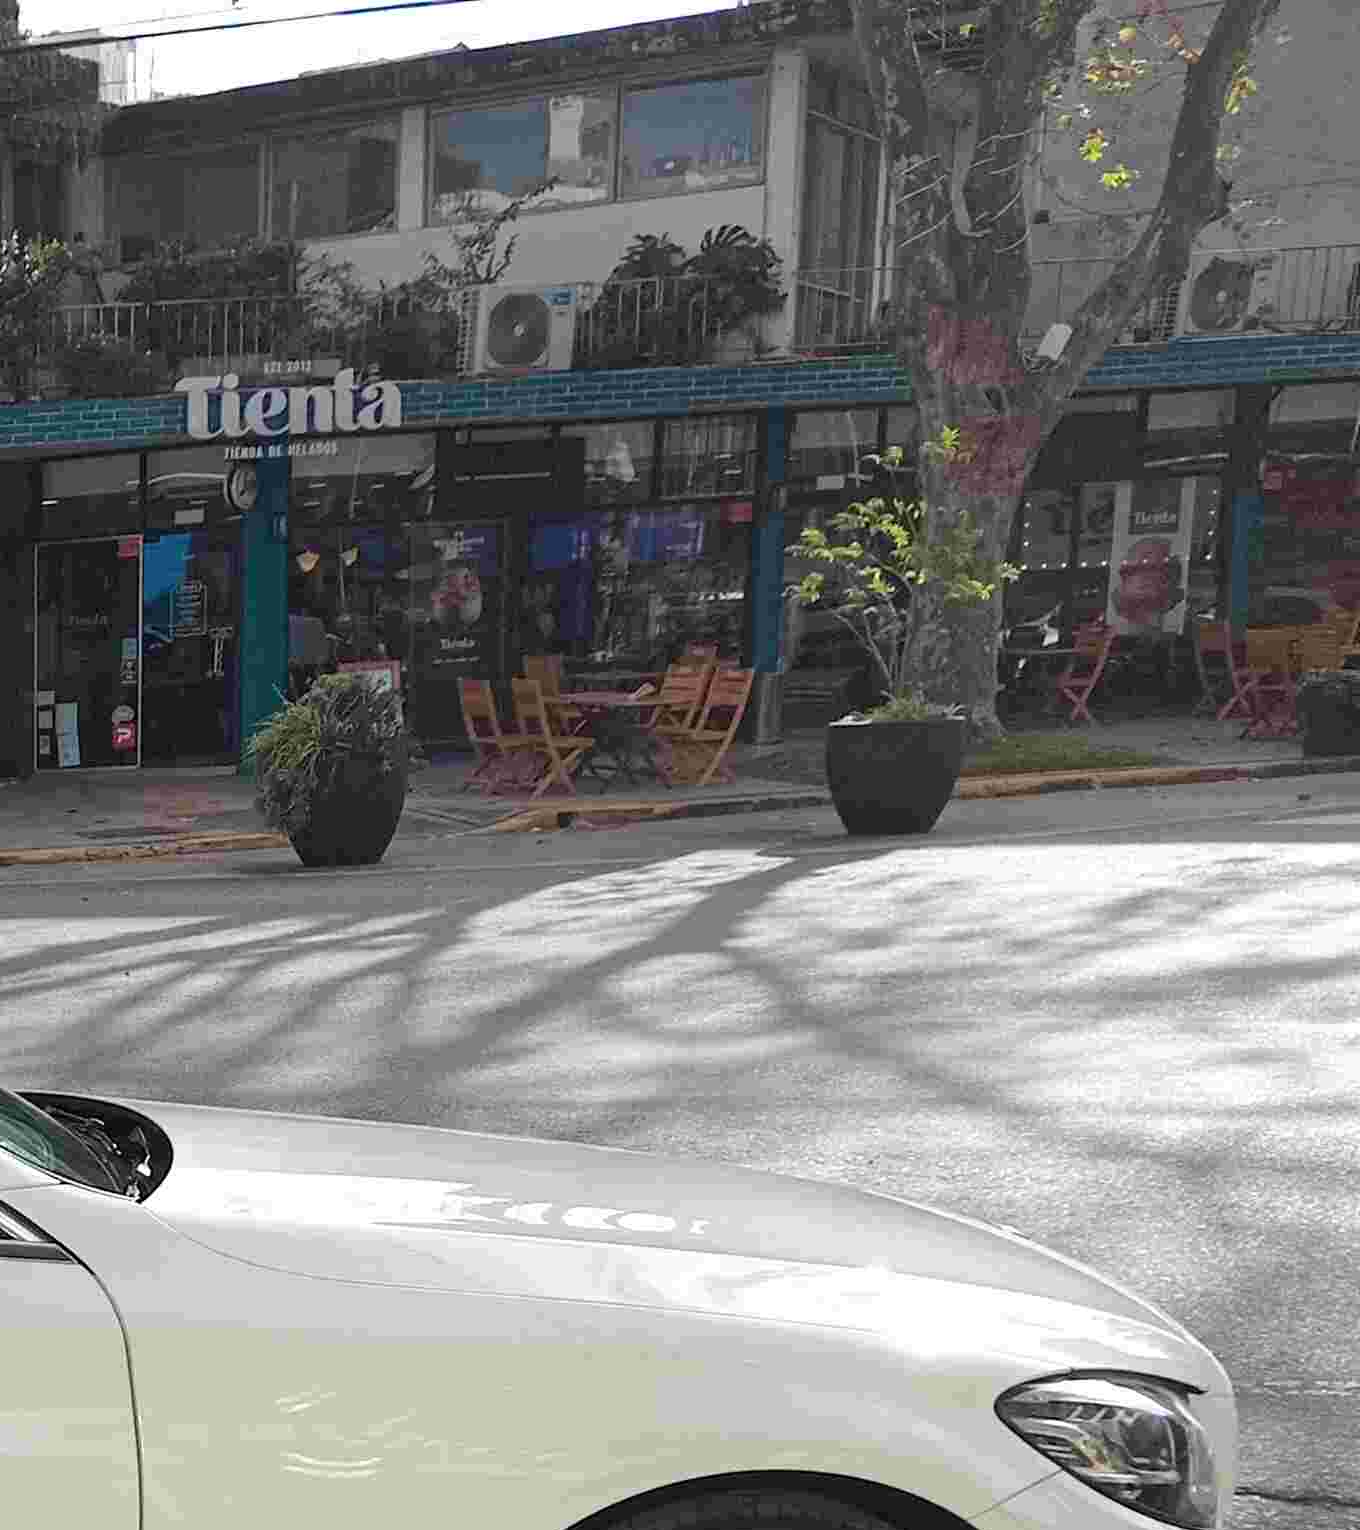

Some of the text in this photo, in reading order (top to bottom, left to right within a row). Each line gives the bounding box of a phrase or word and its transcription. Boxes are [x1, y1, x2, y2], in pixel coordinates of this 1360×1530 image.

[174, 368, 402, 440] Tienta
[224, 446, 264, 461] TIENDA
[268, 445, 283, 458] DE
